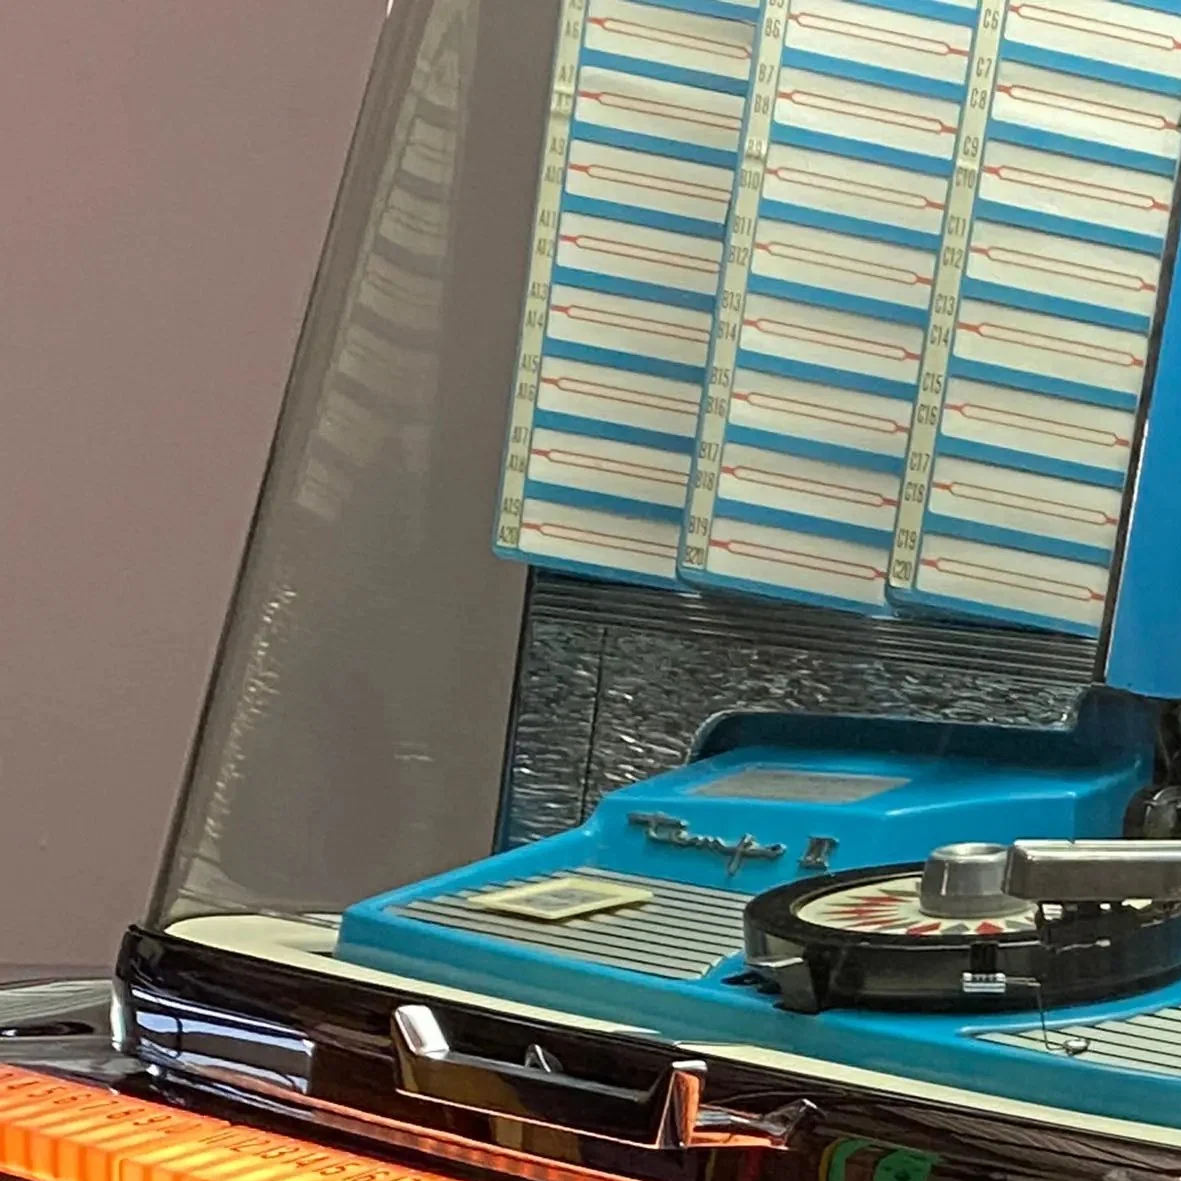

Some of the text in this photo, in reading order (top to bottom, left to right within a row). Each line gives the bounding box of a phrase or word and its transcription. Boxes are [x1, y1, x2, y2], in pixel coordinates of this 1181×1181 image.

[983, 7, 1000, 30] C6
[976, 57, 992, 78] C7
[970, 87, 988, 110] C8
[963, 135, 980, 158] C9
[956, 166, 977, 189] C10
[948, 215, 967, 236] C11
[942, 246, 963, 269] C12
[935, 293, 956, 316] C13
[930, 324, 950, 347] C14
[922, 371, 942, 394] C15
[917, 403, 938, 426] C16
[909, 451, 930, 473] C17
[904, 481, 925, 503] C18
[897, 528, 917, 551] C19
[891, 559, 913, 581] C20
[223, 1137, 270, 1153] 12
[252, 1145, 299, 1160] 13
[280, 1152, 329, 1169] 14
[312, 1158, 360, 1176] 15
